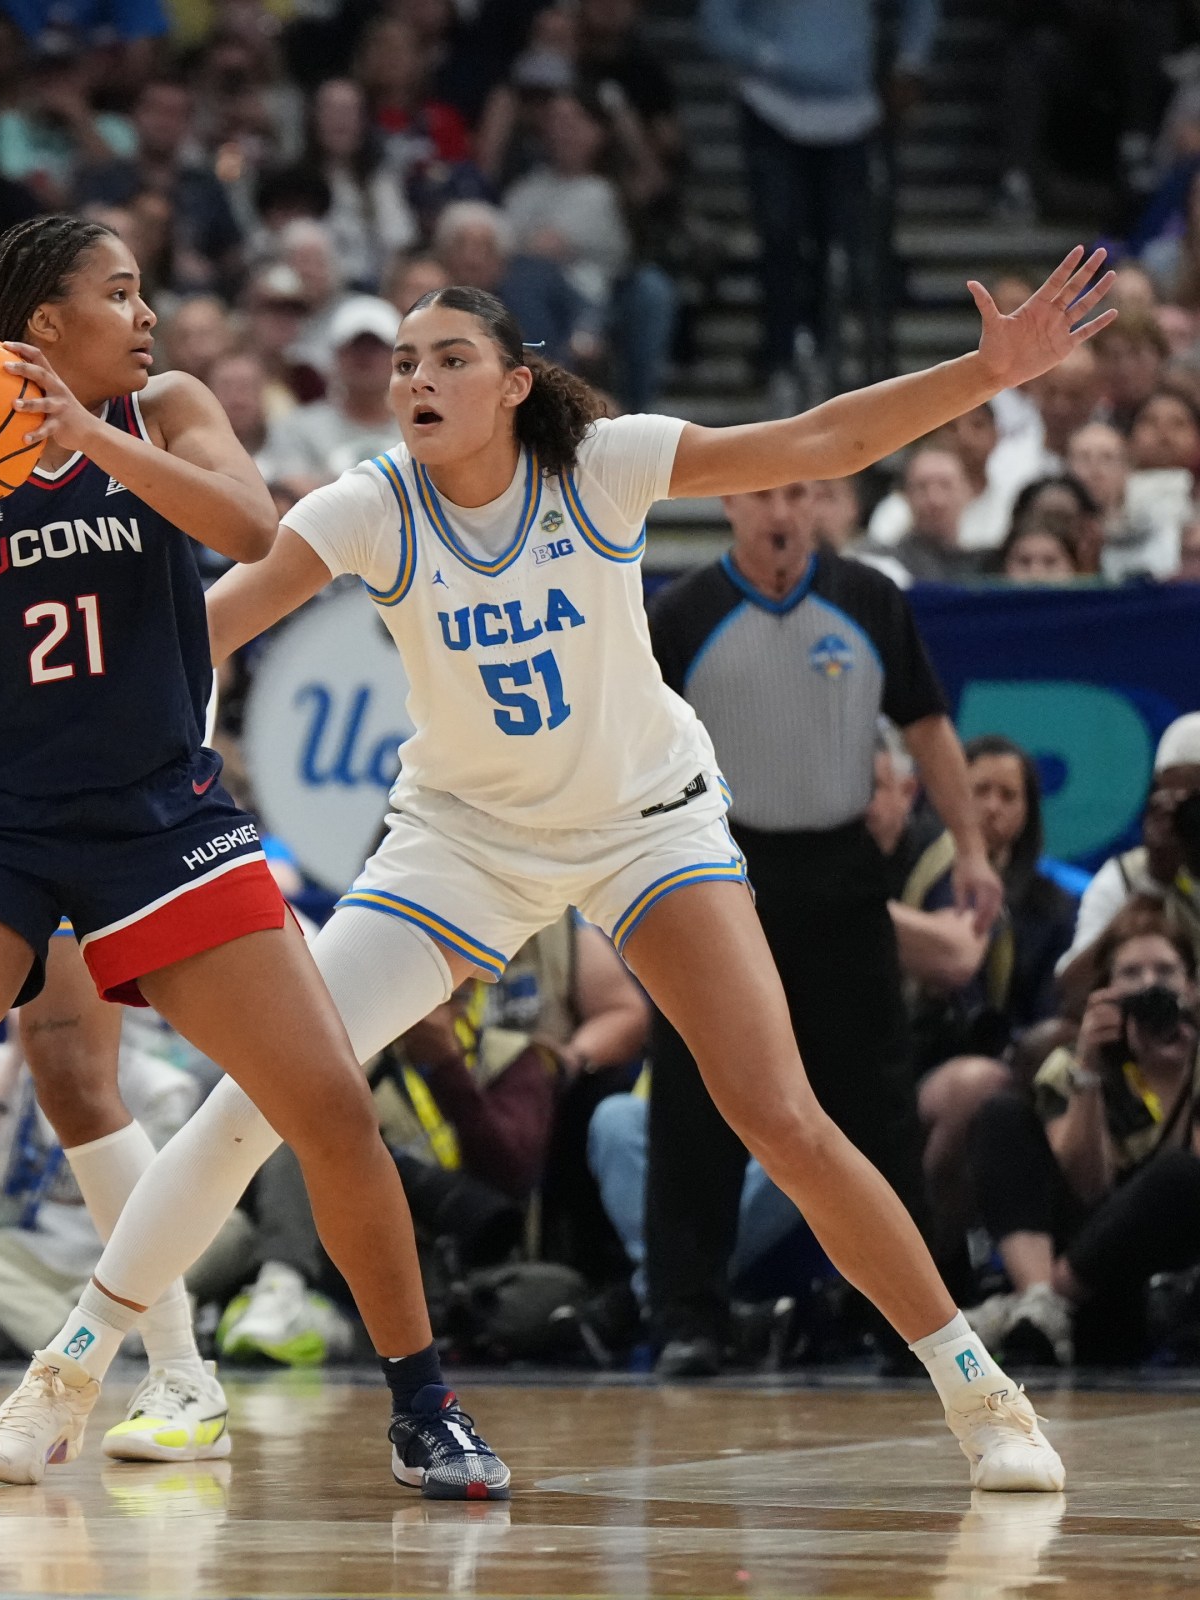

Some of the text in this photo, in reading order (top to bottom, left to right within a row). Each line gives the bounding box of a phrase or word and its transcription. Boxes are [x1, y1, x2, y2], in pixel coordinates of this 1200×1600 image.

[23, 593, 106, 685] 21
[437, 588, 586, 651] UCLA
[478, 648, 571, 736] 51
[182, 823, 260, 871] HUSKIES
